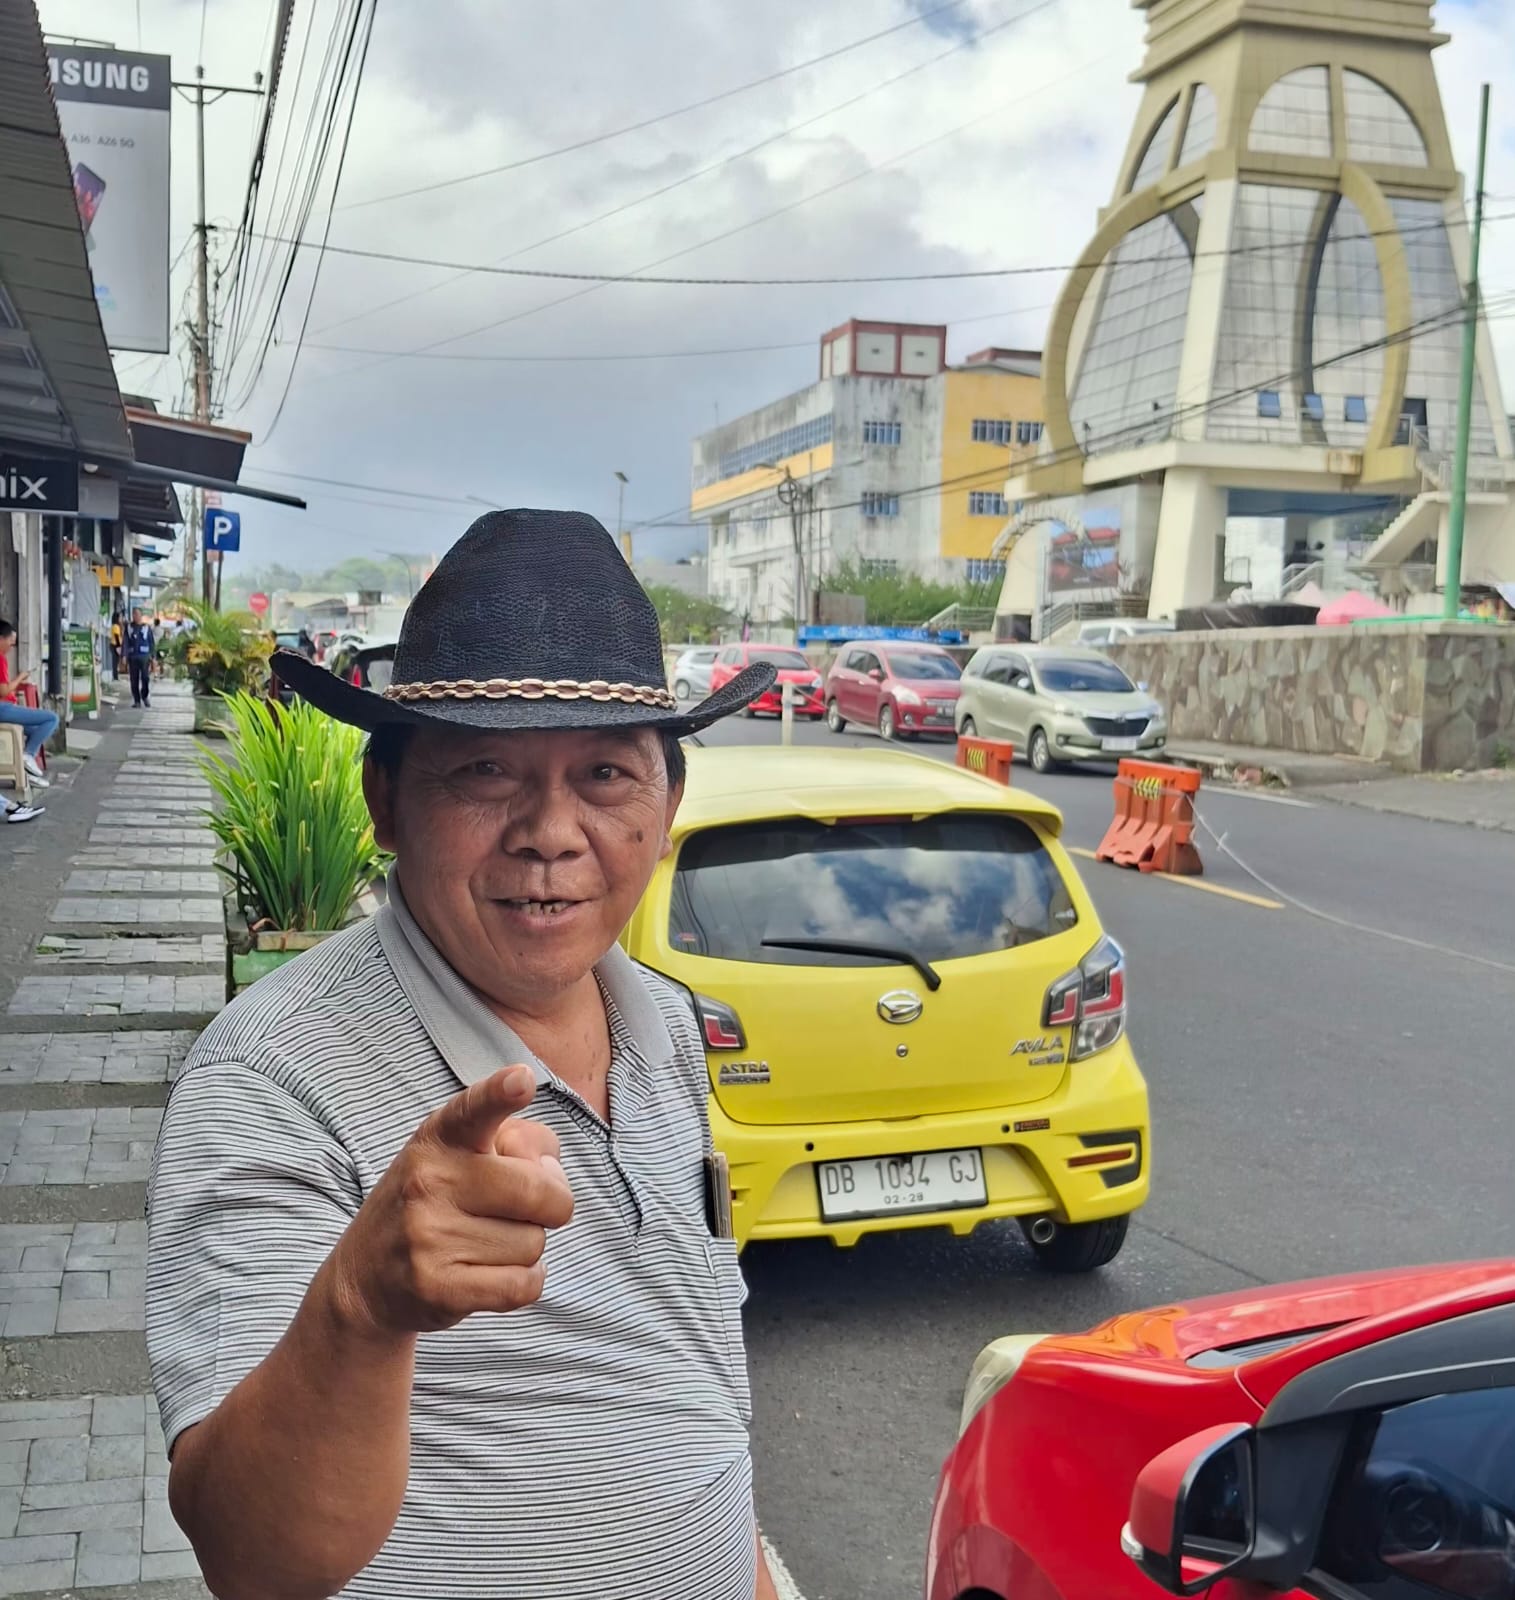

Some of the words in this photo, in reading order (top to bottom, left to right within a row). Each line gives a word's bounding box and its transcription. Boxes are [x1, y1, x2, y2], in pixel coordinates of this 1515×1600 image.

[213, 516, 233, 545] P
[719, 1060, 770, 1074] ASTRA
[825, 1164, 855, 1195] DB
[874, 1157, 930, 1191] 1034
[948, 1153, 978, 1183] GJ
